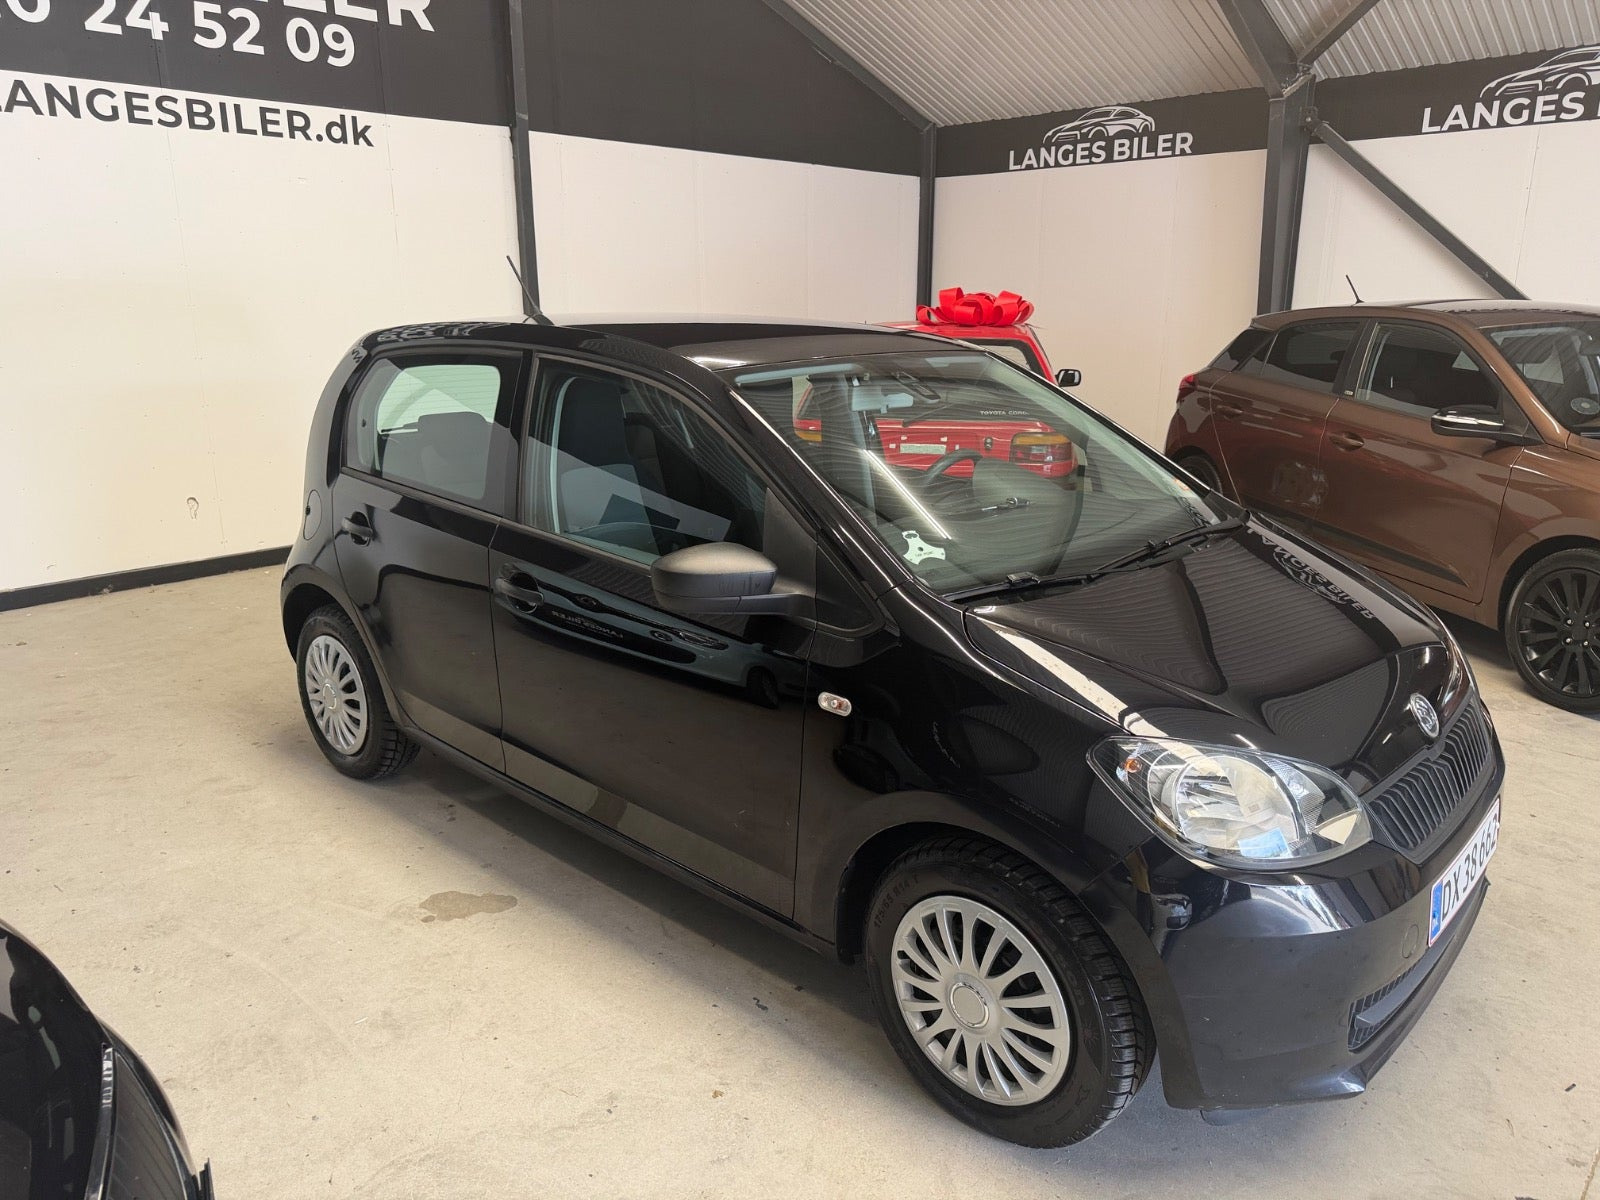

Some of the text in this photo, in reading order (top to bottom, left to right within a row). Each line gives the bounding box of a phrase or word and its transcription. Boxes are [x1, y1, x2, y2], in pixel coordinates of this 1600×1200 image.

[84, 0, 170, 41] 24
[193, 0, 265, 56] 52
[285, 16, 356, 67] 09
[0, 79, 375, 147] ANGESBILER.dk
[1421, 91, 1586, 134] LANGES
[1008, 132, 1194, 171] LANGES BILER
[1441, 865, 1461, 922] DX
[1463, 843, 1478, 894] 38
